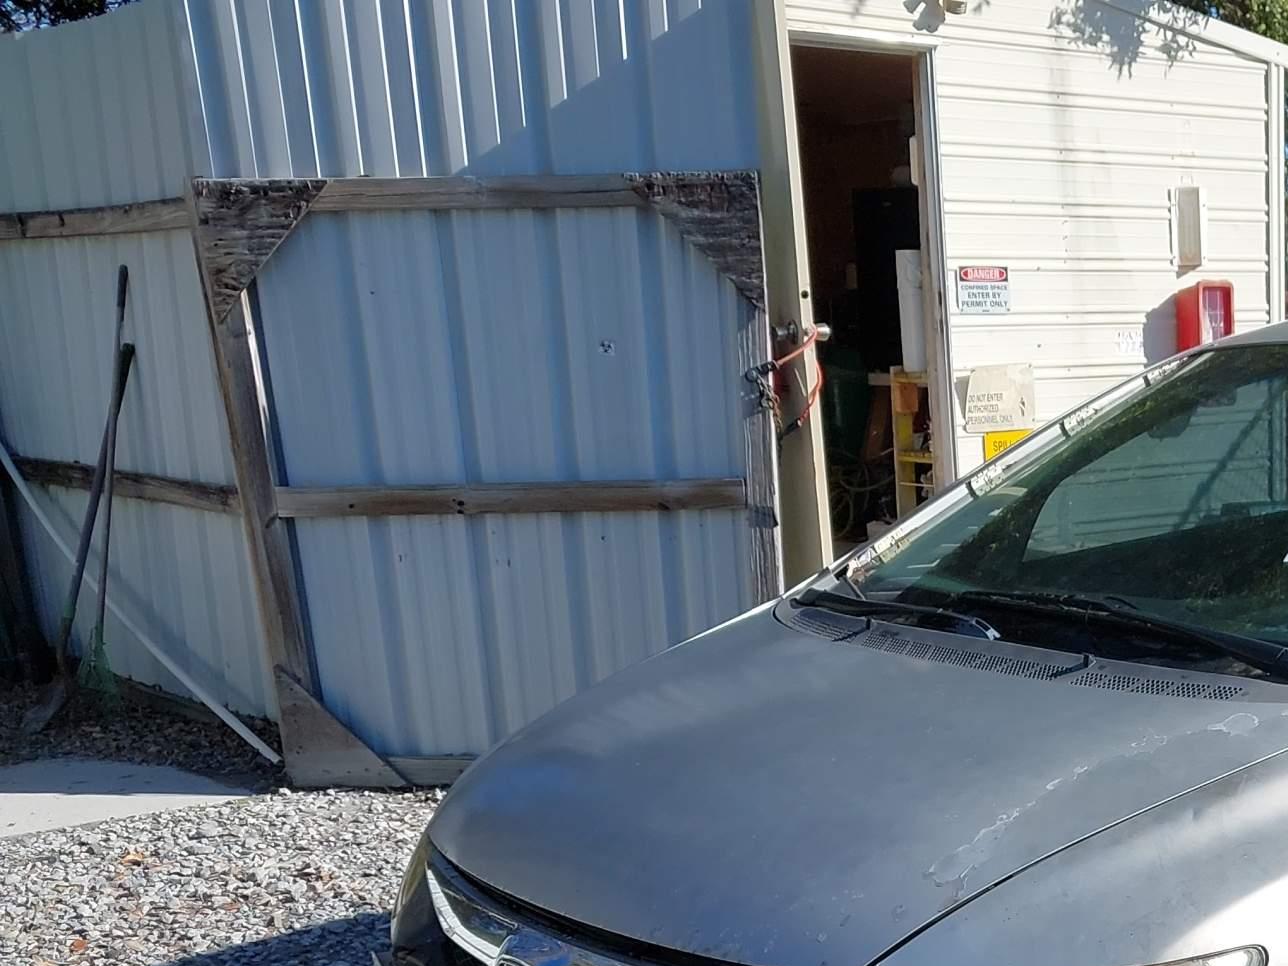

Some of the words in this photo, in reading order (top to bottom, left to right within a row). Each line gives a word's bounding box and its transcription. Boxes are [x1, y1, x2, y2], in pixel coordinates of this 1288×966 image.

[968, 269, 999, 280] DANGER
[967, 291, 990, 299] ENTER
[991, 291, 1001, 299] BY
[968, 394, 975, 403] DO
[976, 393, 986, 402] NOT
[987, 392, 1003, 402] ENTER
[968, 403, 999, 413] AUTHORIZED
[968, 415, 998, 424] PERSONNEL
